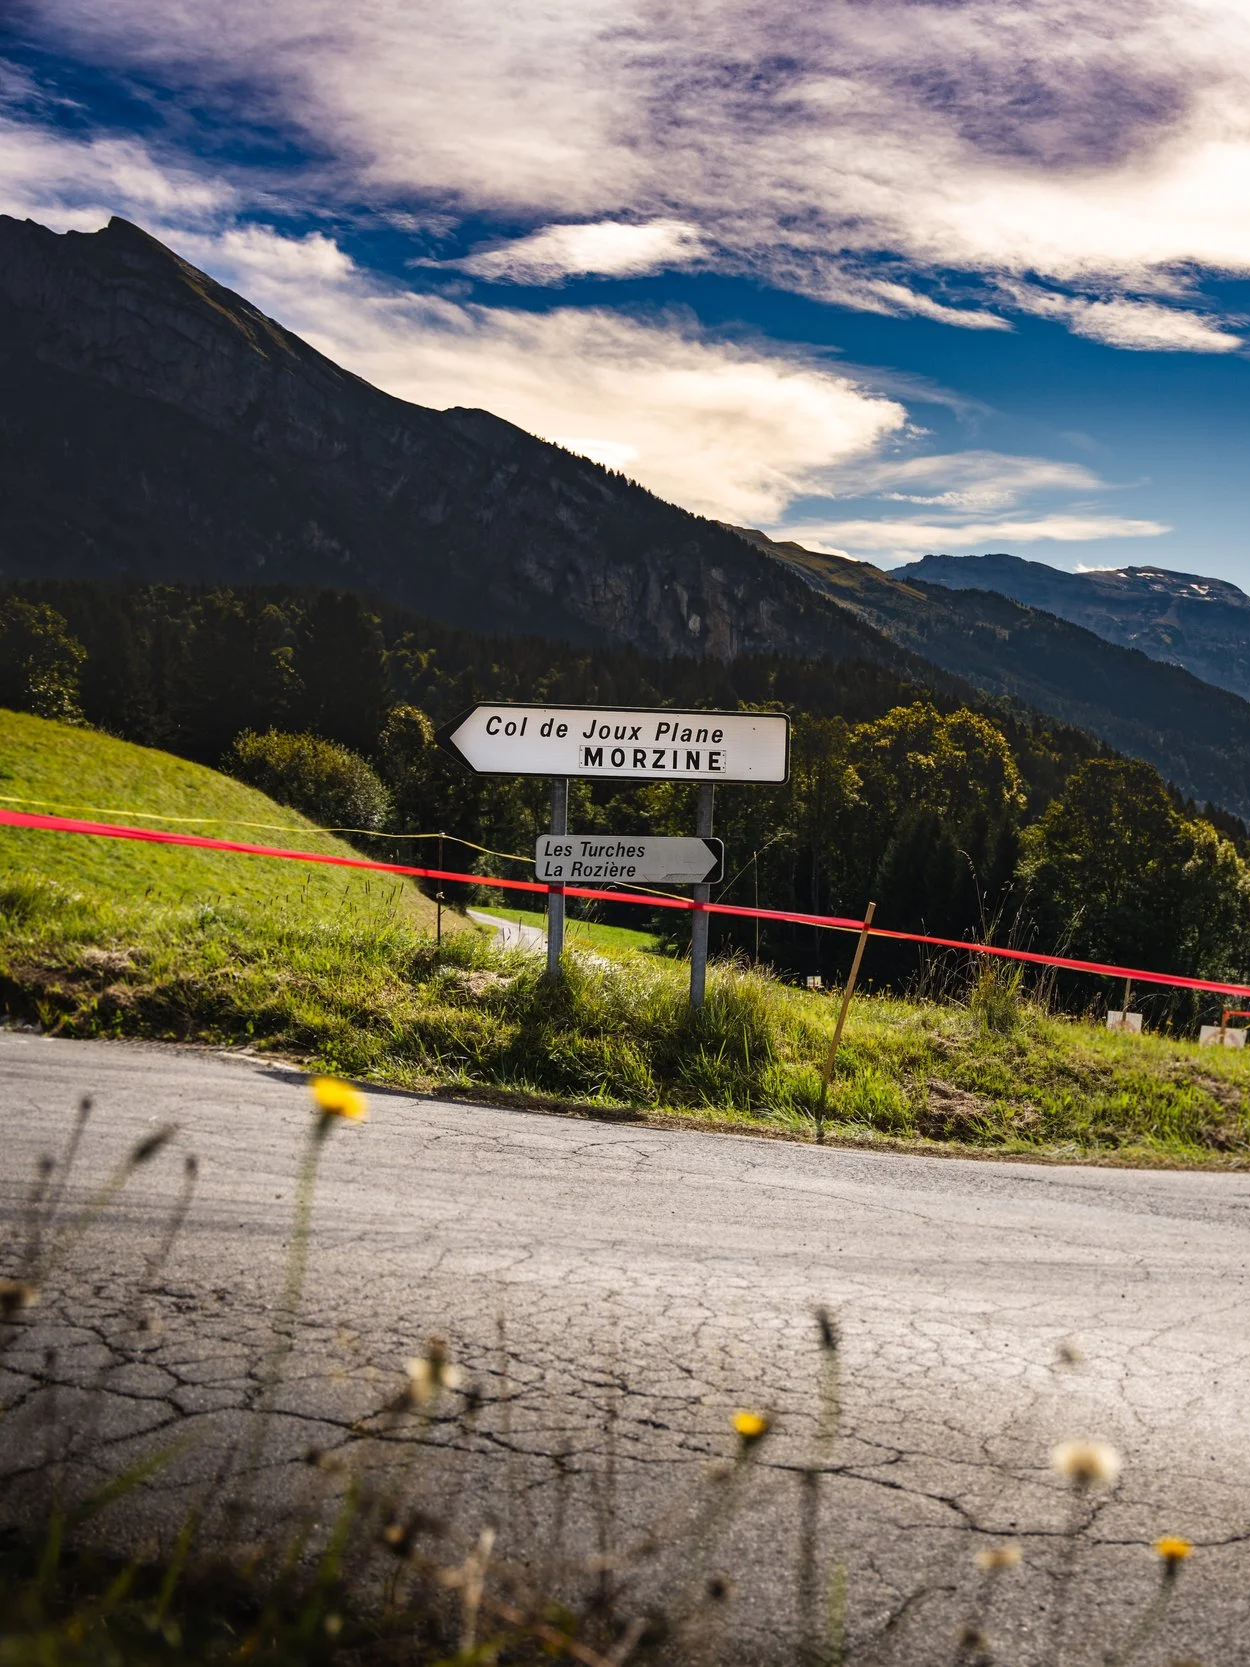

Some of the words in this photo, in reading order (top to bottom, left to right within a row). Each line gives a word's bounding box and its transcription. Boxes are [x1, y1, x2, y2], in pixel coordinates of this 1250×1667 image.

[485, 715, 527, 738] Col
[540, 717, 569, 739] de
[582, 719, 643, 742] Joux
[655, 721, 725, 745] Plane
[583, 746, 722, 772] MORZINE
[544, 841, 573, 858] Les
[580, 841, 646, 859] Turches
[544, 861, 565, 877] La
[571, 860, 637, 878] Rozière
